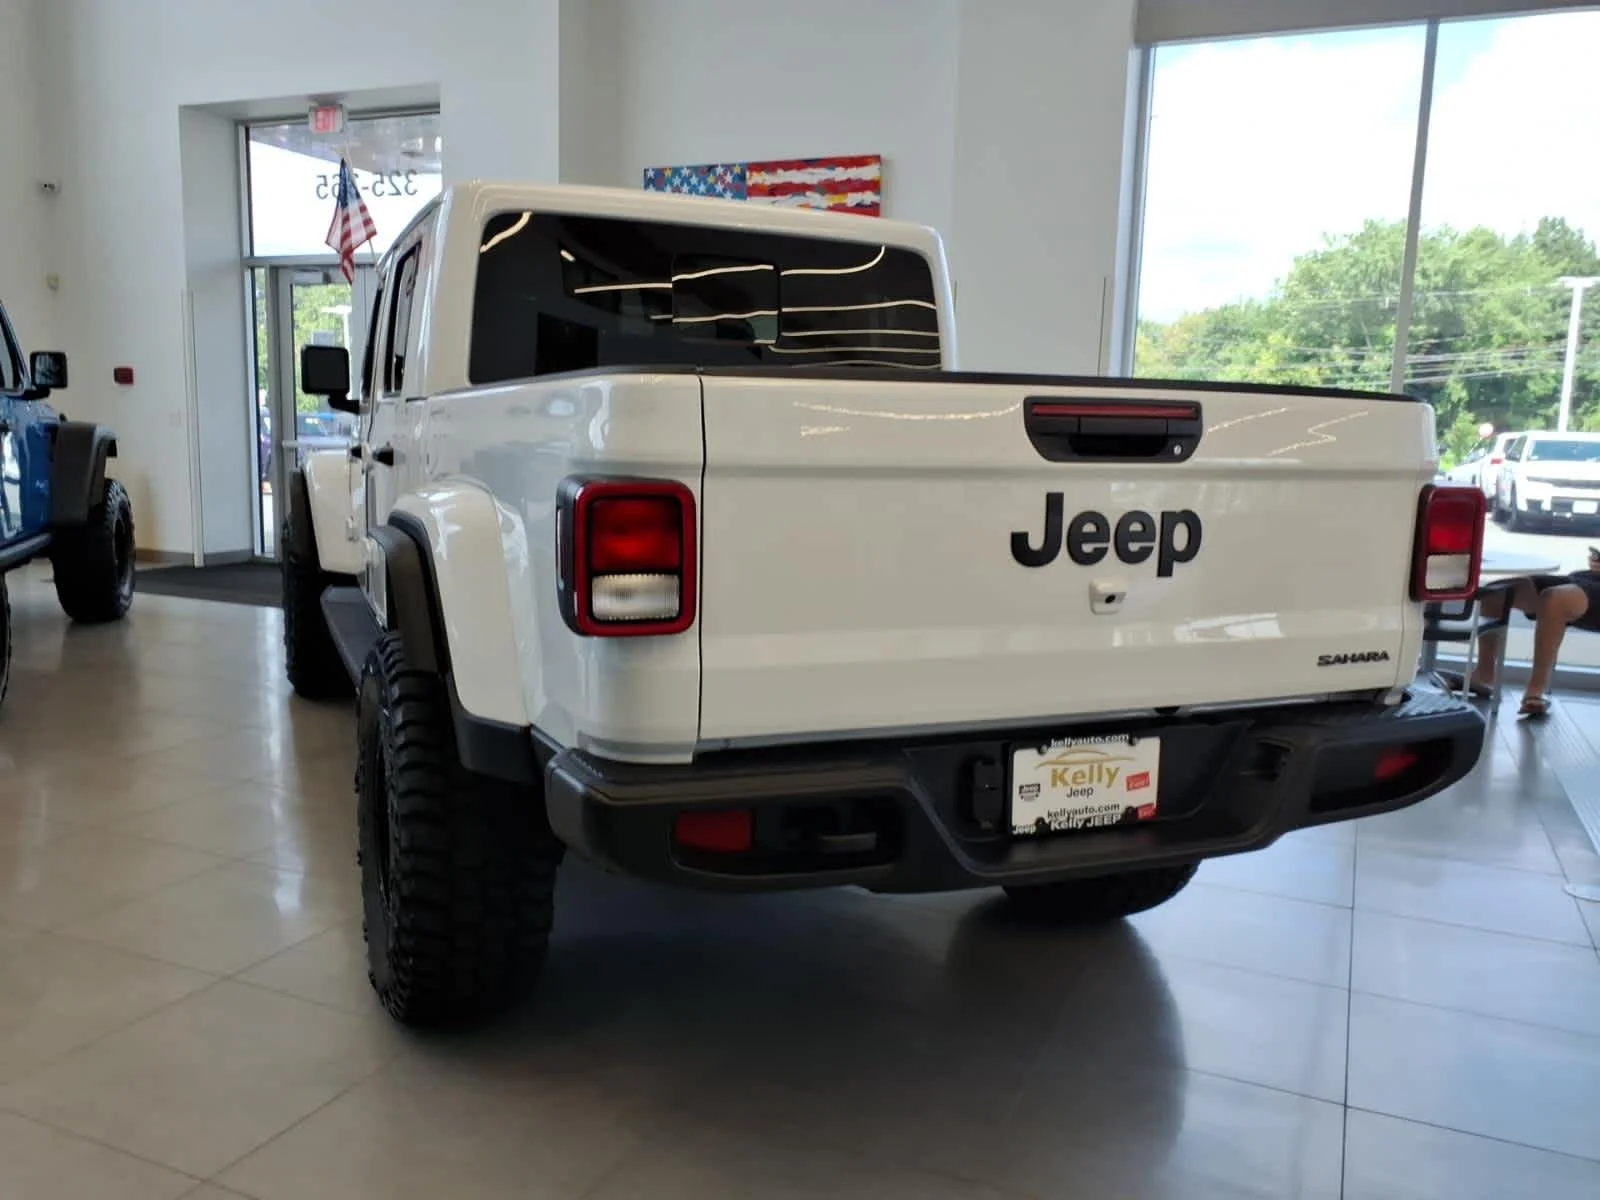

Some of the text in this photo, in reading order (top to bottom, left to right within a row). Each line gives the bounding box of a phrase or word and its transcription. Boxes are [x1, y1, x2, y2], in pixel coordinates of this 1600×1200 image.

[1010, 492, 1202, 578] Jeep
[1317, 650, 1390, 667] SAHARA
[1050, 733, 1130, 749] kellyauto.com
[1051, 761, 1121, 789] Kelly
[1066, 787, 1094, 799] Jeep
[1047, 802, 1121, 819] kellyauto.com
[1050, 813, 1122, 831] Kelly JEEP
